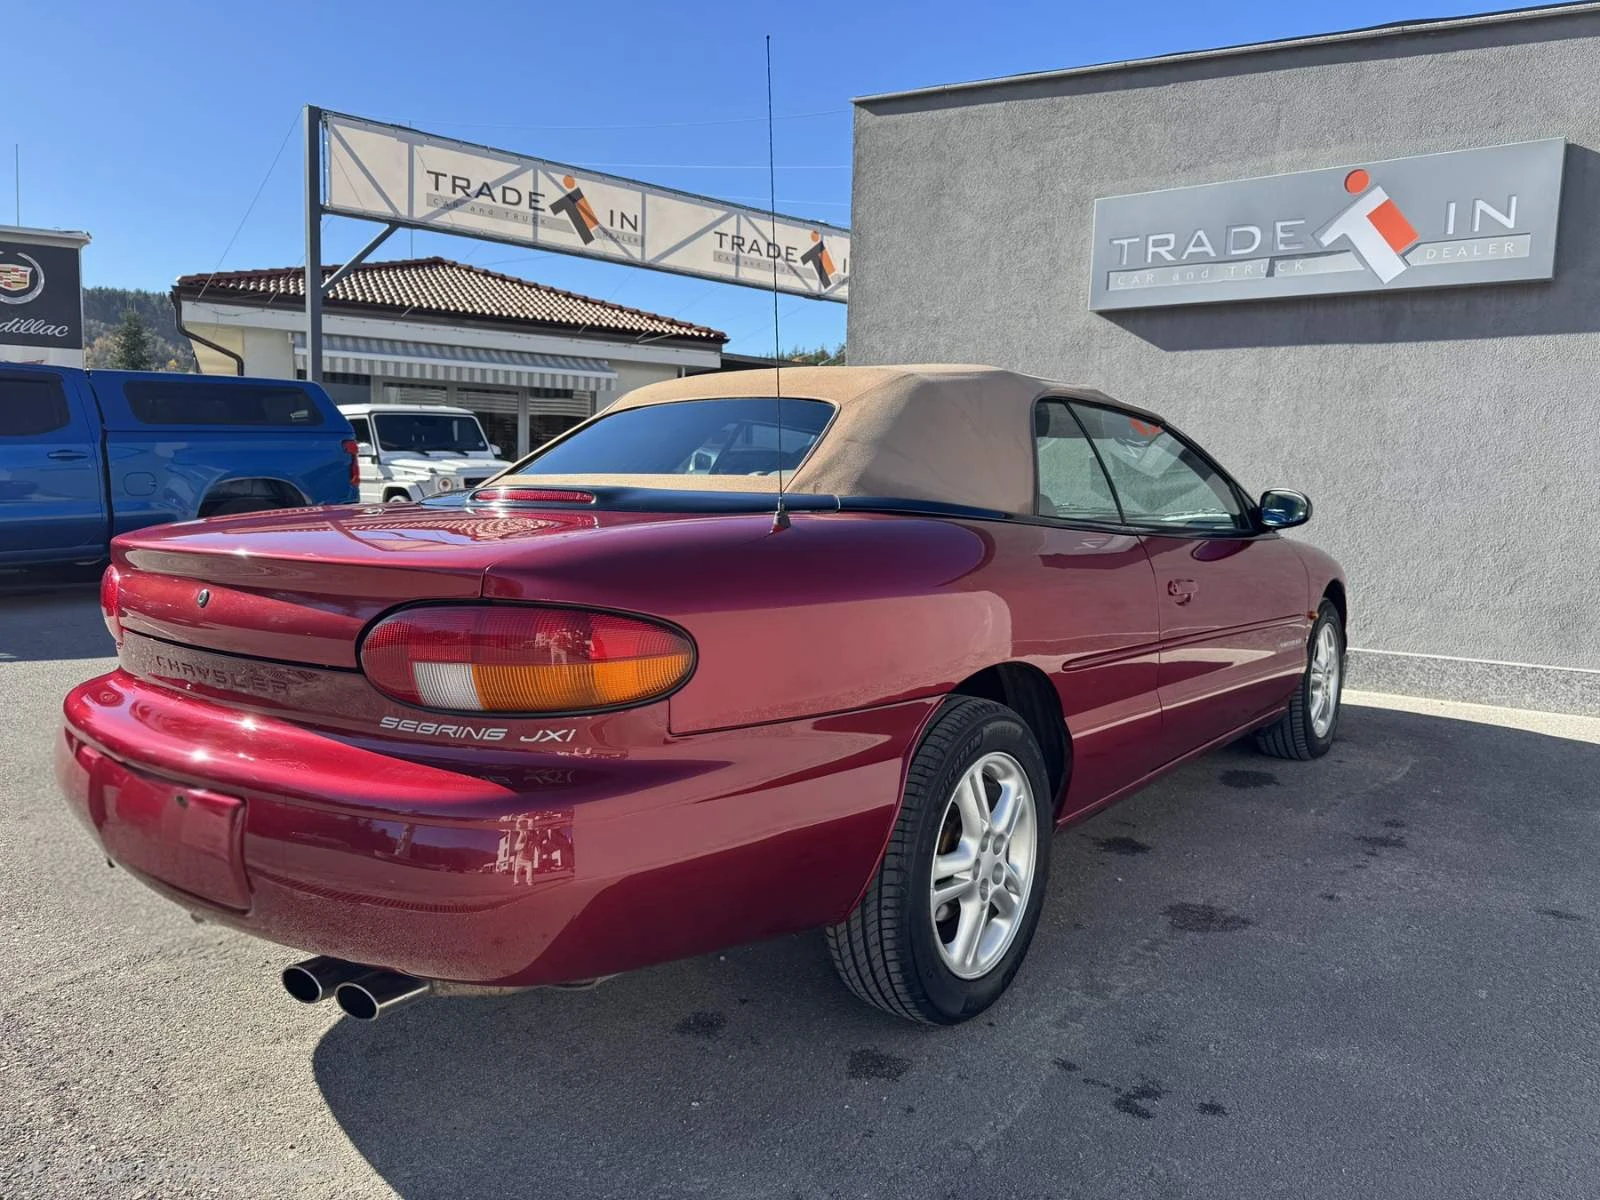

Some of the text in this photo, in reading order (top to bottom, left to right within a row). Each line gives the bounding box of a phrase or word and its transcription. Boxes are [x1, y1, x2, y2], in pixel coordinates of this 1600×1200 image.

[427, 170, 546, 213] TRADE
[609, 209, 638, 232] IN
[714, 231, 798, 263] TRADE
[1111, 219, 1305, 265] TRADE
[1446, 194, 1518, 235] IN
[1118, 274, 1155, 286] CAR
[1172, 269, 1209, 281] and
[1426, 242, 1515, 260] DEALER
[0, 317, 69, 337] dillac
[156, 656, 289, 695] CHRYSLER
[380, 716, 576, 743] SEBRING JXI
